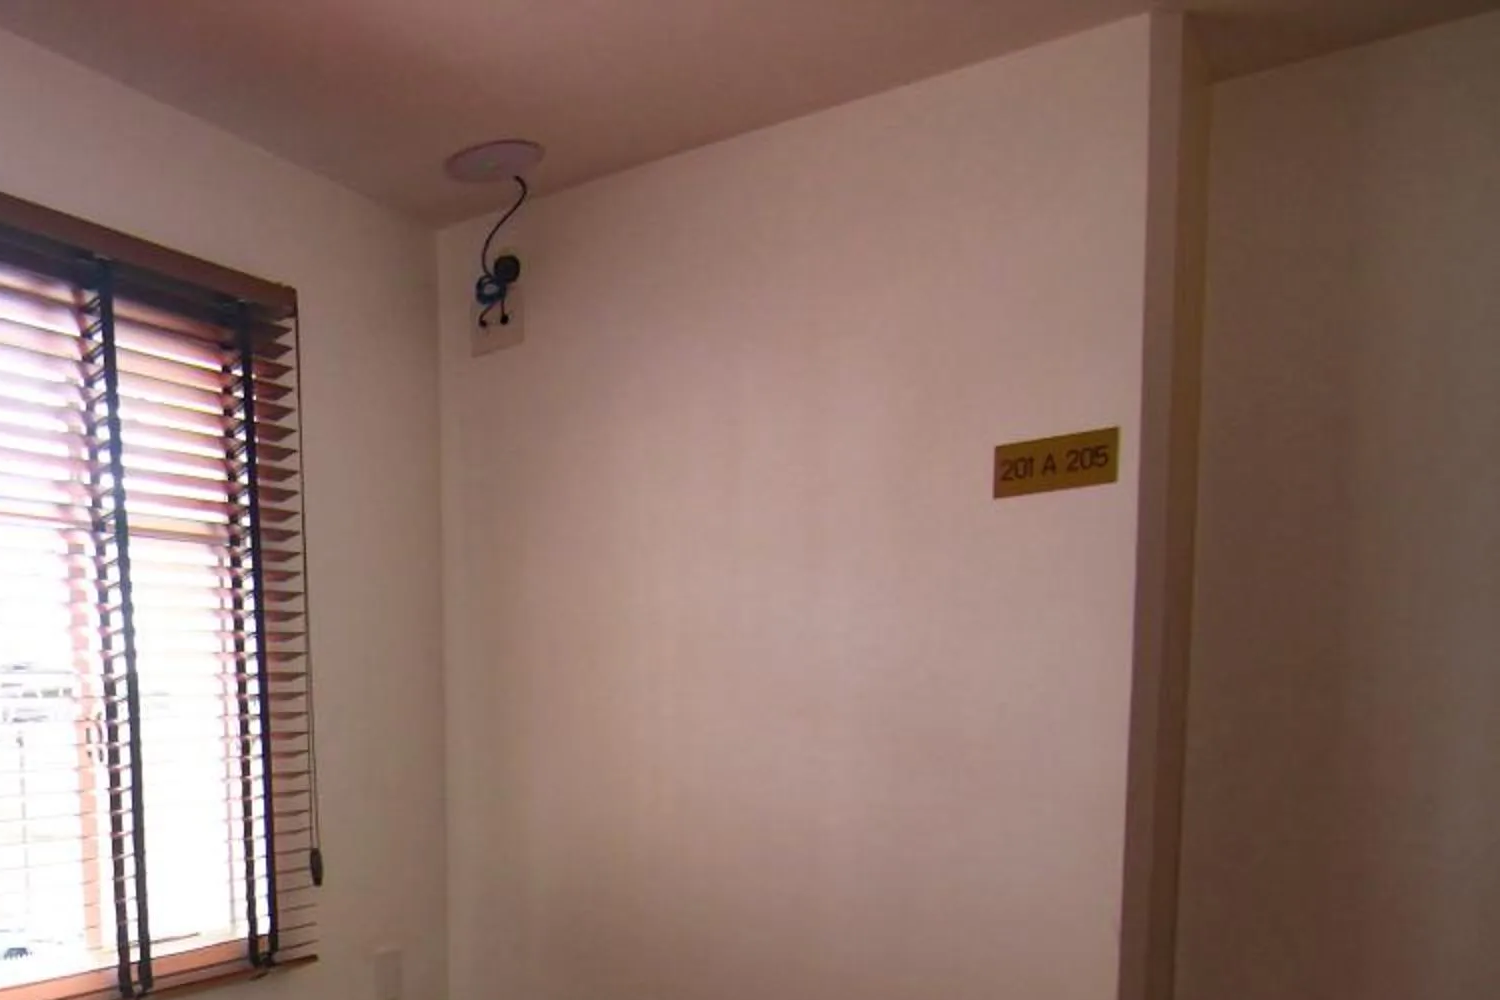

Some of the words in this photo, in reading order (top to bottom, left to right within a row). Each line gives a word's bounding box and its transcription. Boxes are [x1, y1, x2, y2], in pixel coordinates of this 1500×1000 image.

[1001, 457, 1035, 481] 201
[1042, 452, 1057, 476] A
[1066, 445, 1109, 472] 205
